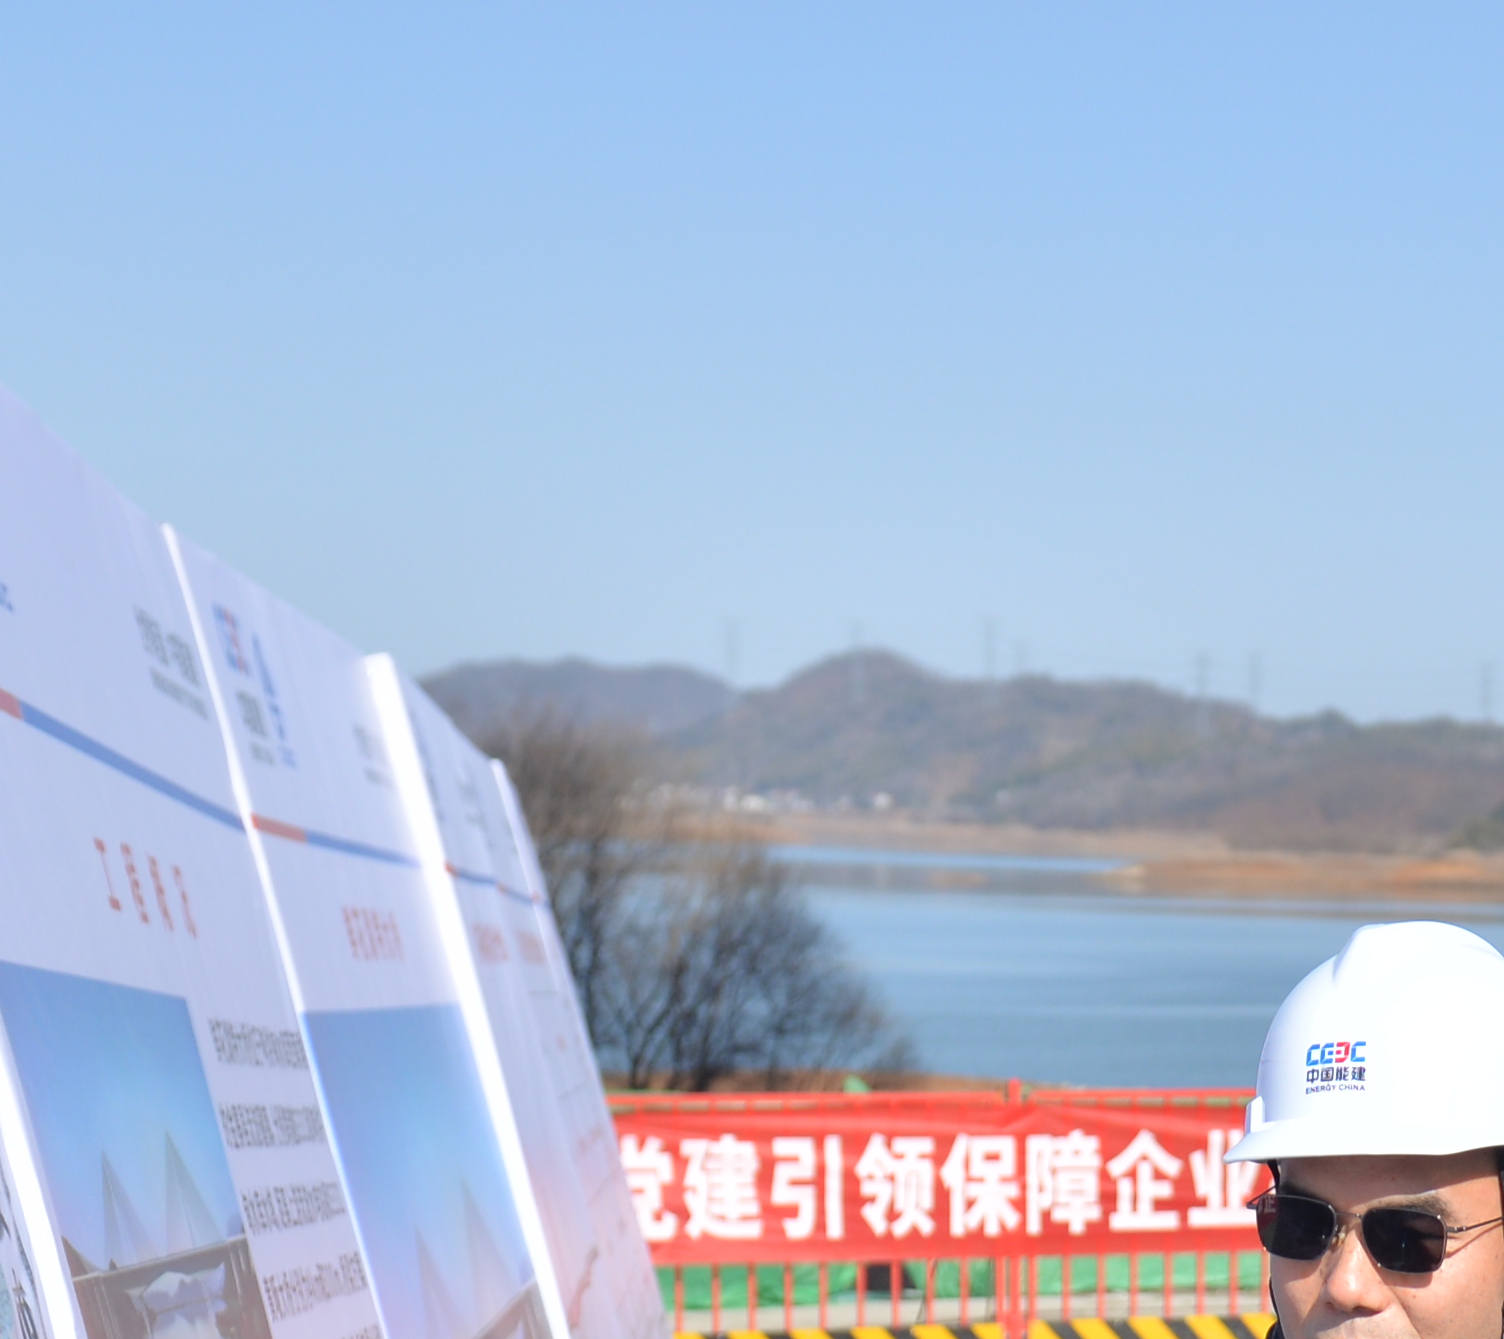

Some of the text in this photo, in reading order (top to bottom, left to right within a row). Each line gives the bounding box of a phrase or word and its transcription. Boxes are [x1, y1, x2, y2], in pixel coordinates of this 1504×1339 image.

[1305, 1066, 1367, 1084] 中国能建
[1305, 1083, 1366, 1095] ENERGY CHINA
